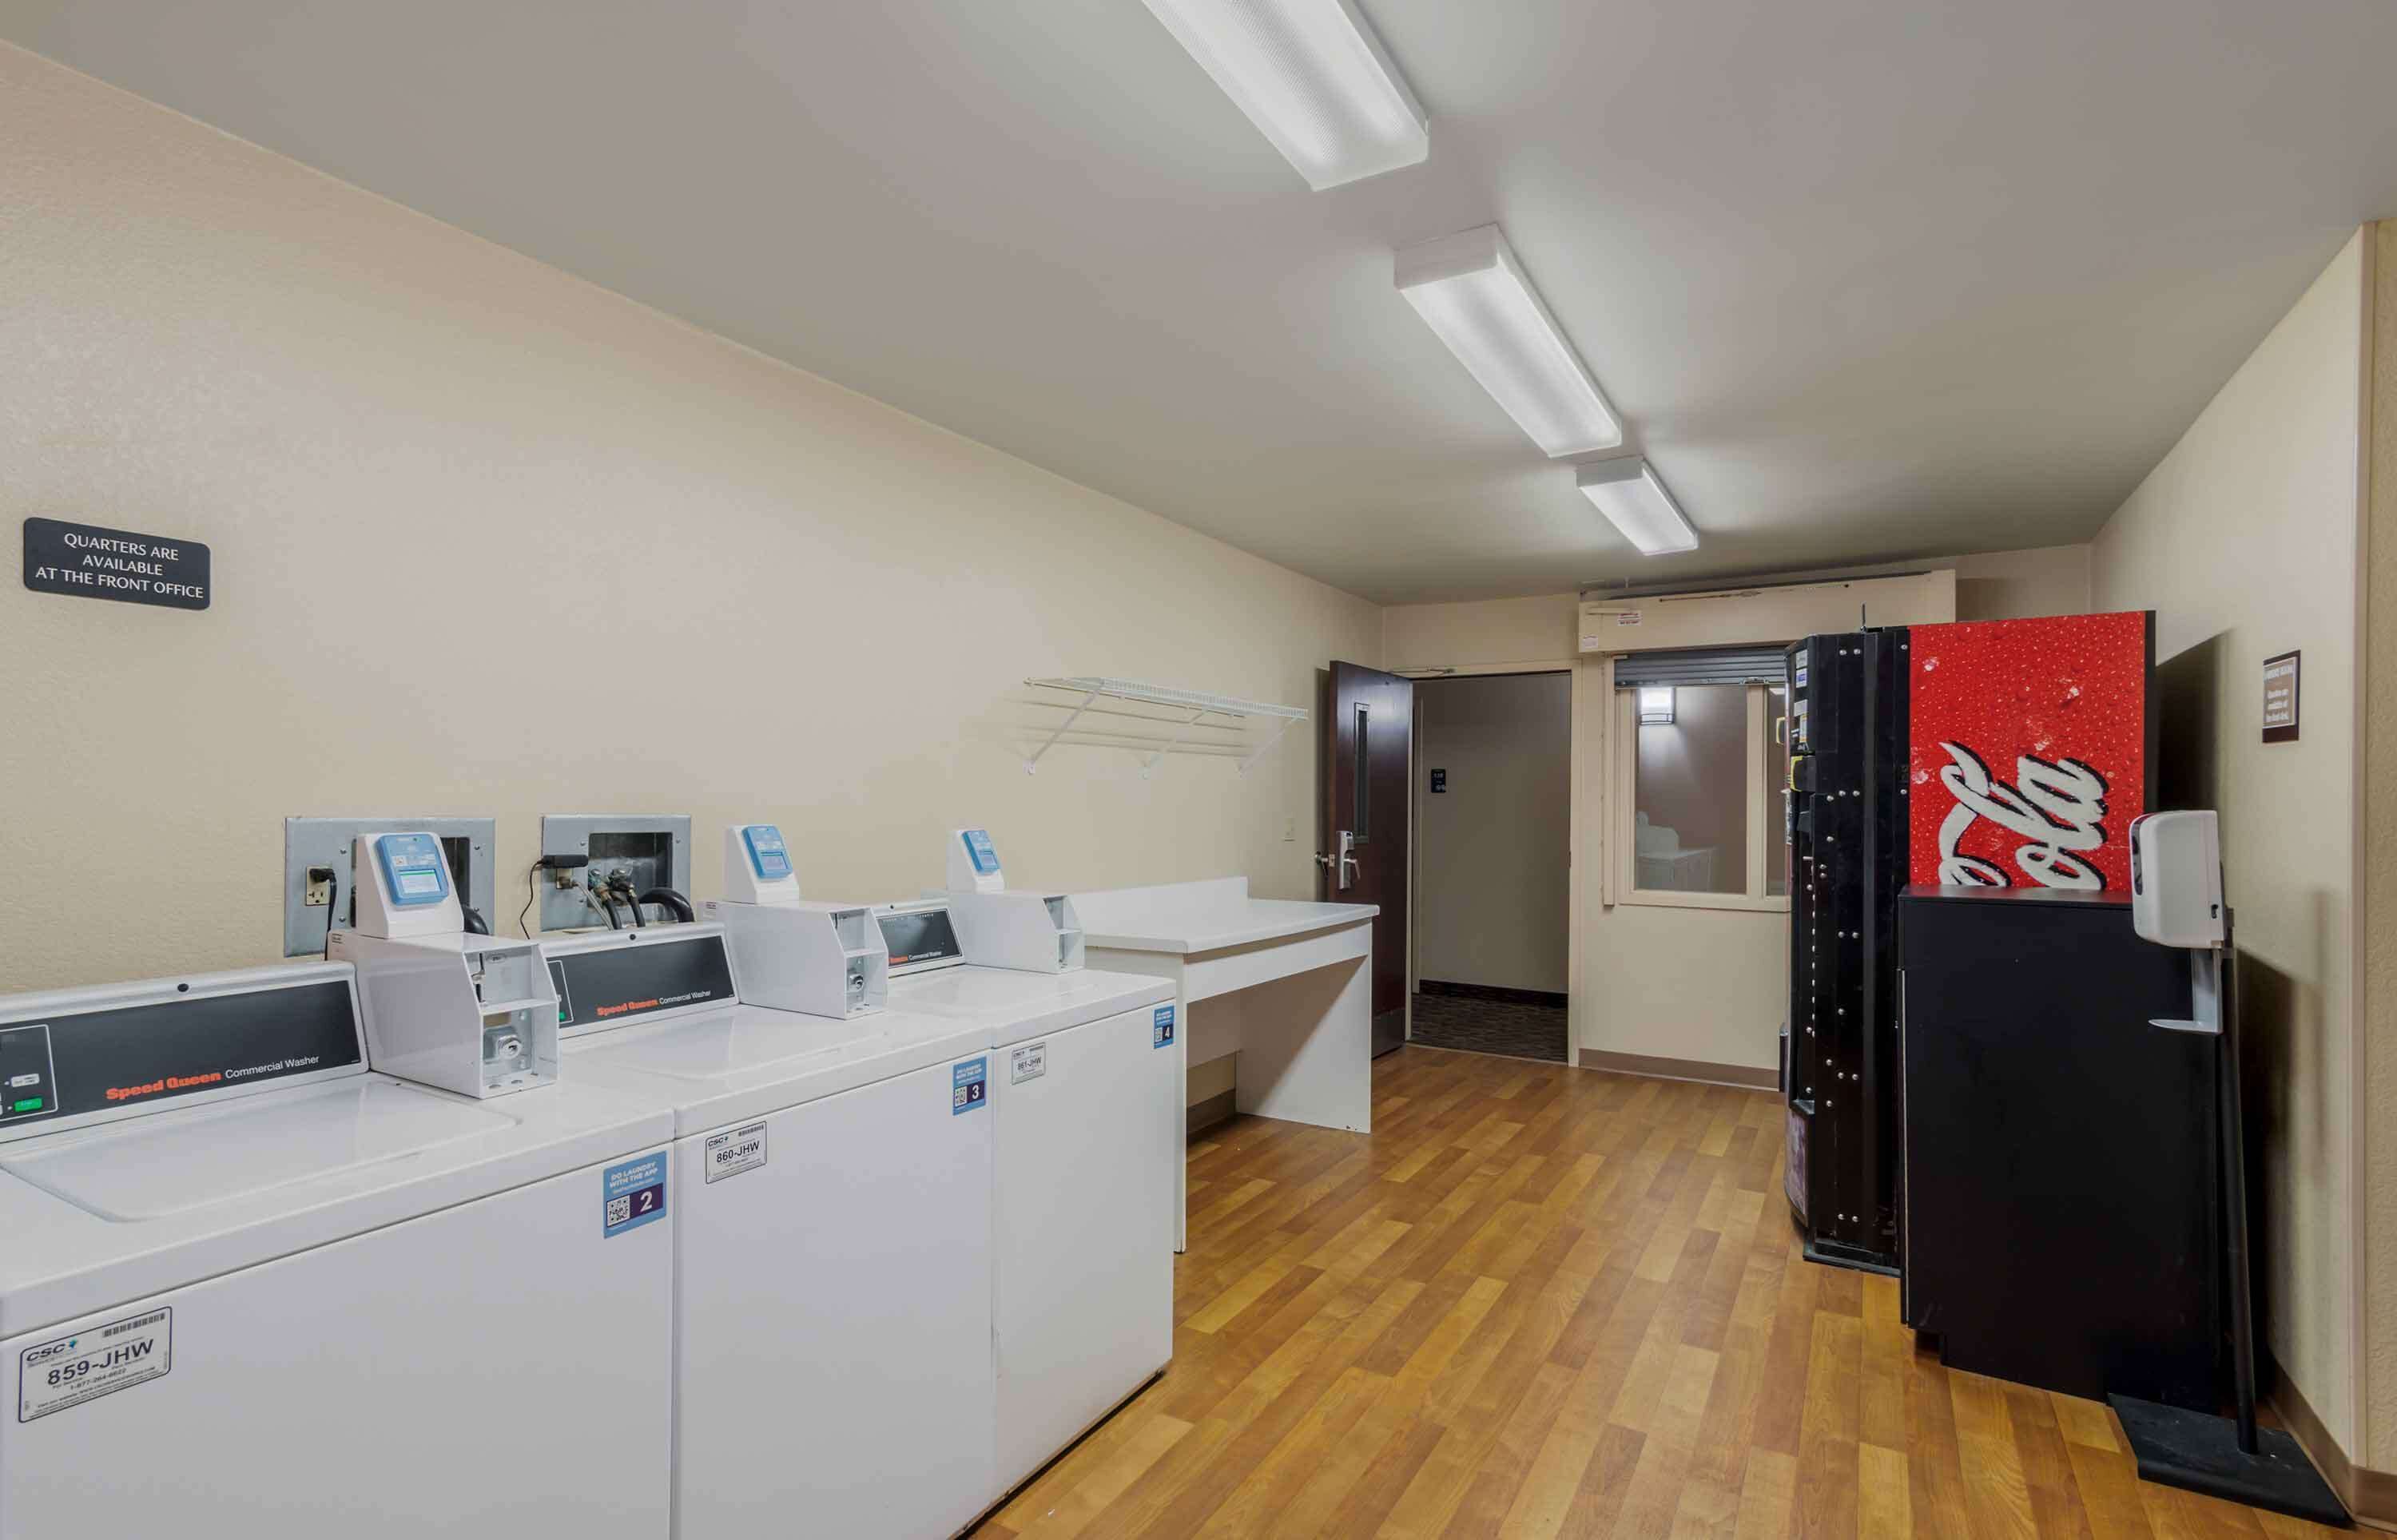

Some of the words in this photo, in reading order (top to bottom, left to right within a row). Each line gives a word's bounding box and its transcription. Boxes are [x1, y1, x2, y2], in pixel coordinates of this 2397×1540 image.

[64, 533, 146, 556] QUARTERS
[150, 546, 179, 561] ARE
[82, 554, 163, 576] AVAILABLE
[35, 567, 58, 580] AT
[61, 569, 93, 585] THE
[98, 574, 150, 591] FRONT
[153, 581, 204, 598] OFFICE
[597, 1003, 627, 1017] Speed
[658, 992, 692, 1005] Commercial
[692, 990, 711, 999] Washer
[105, 1079, 164, 1100] Speed
[167, 1071, 221, 1089] Queen
[225, 1061, 284, 1079] Commercial
[284, 1055, 320, 1069] Washer
[972, 1085, 980, 1100] 3
[708, 1137, 724, 1147] CSC
[717, 1140, 760, 1163] 860-JHW
[623, 1161, 657, 1177] LAUNDRY
[640, 1191, 653, 1213] 2
[26, 1344, 66, 1362] CSC
[47, 1339, 154, 1386] 859-JHW
